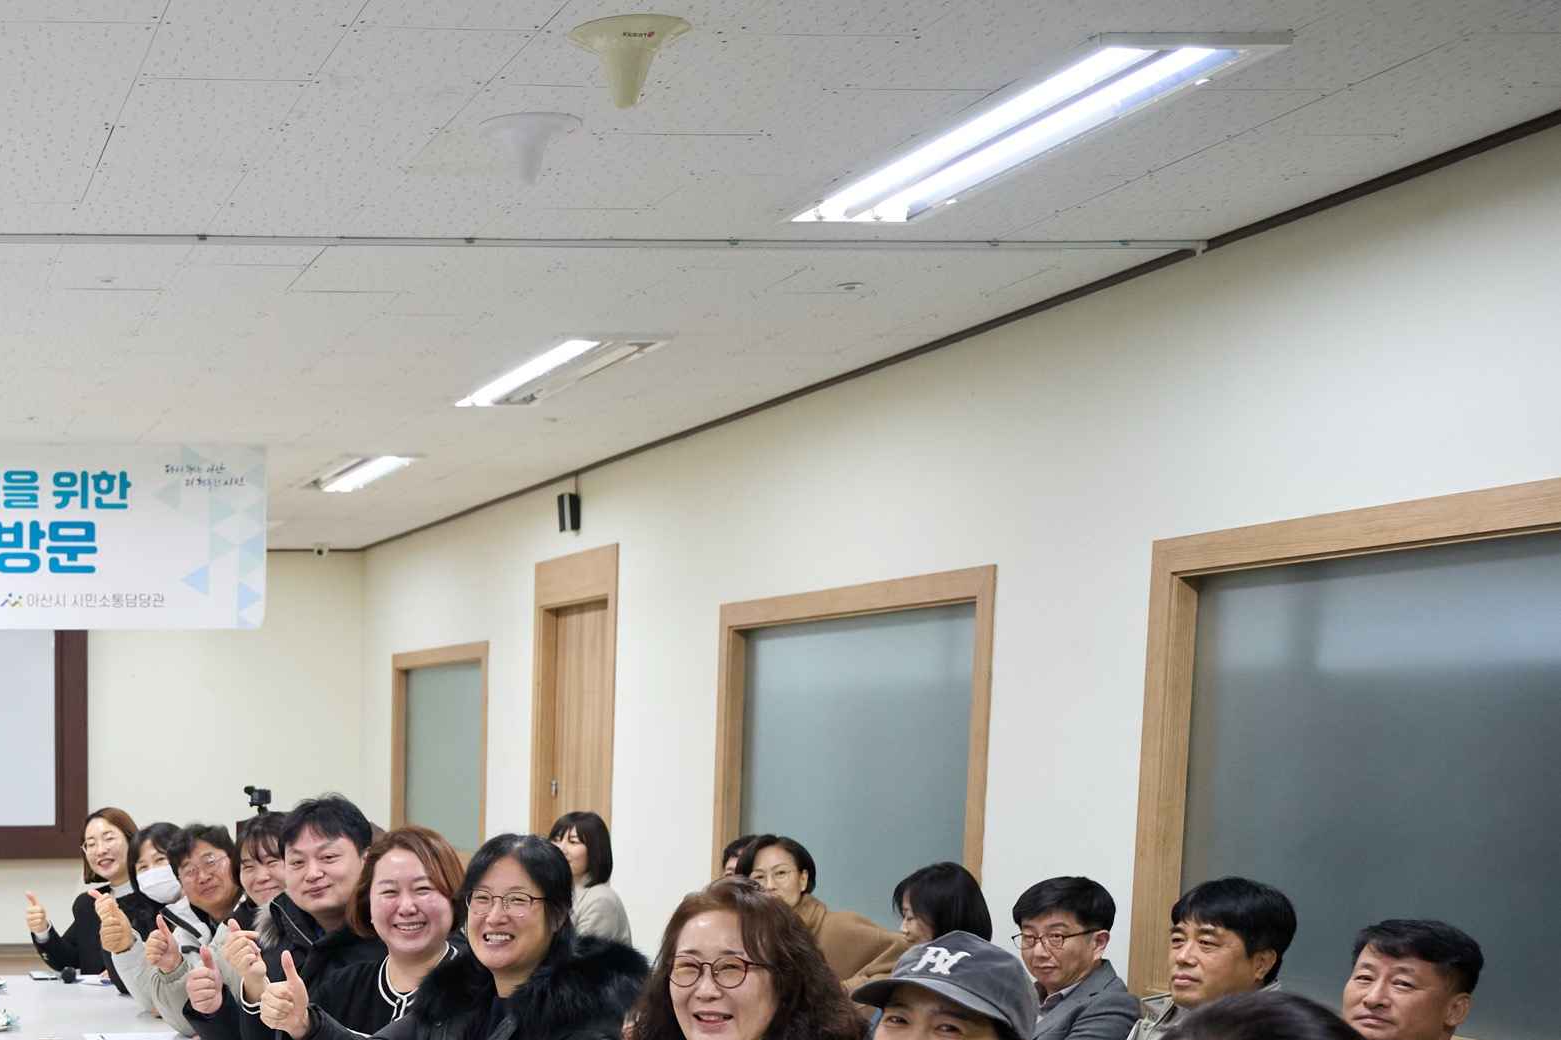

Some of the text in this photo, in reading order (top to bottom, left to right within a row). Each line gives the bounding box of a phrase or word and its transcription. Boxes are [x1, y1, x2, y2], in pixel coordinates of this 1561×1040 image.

[51, 468, 132, 511] 위한
[26, 592, 68, 608] 아산시
[71, 592, 166, 609] 시민소통담당관
